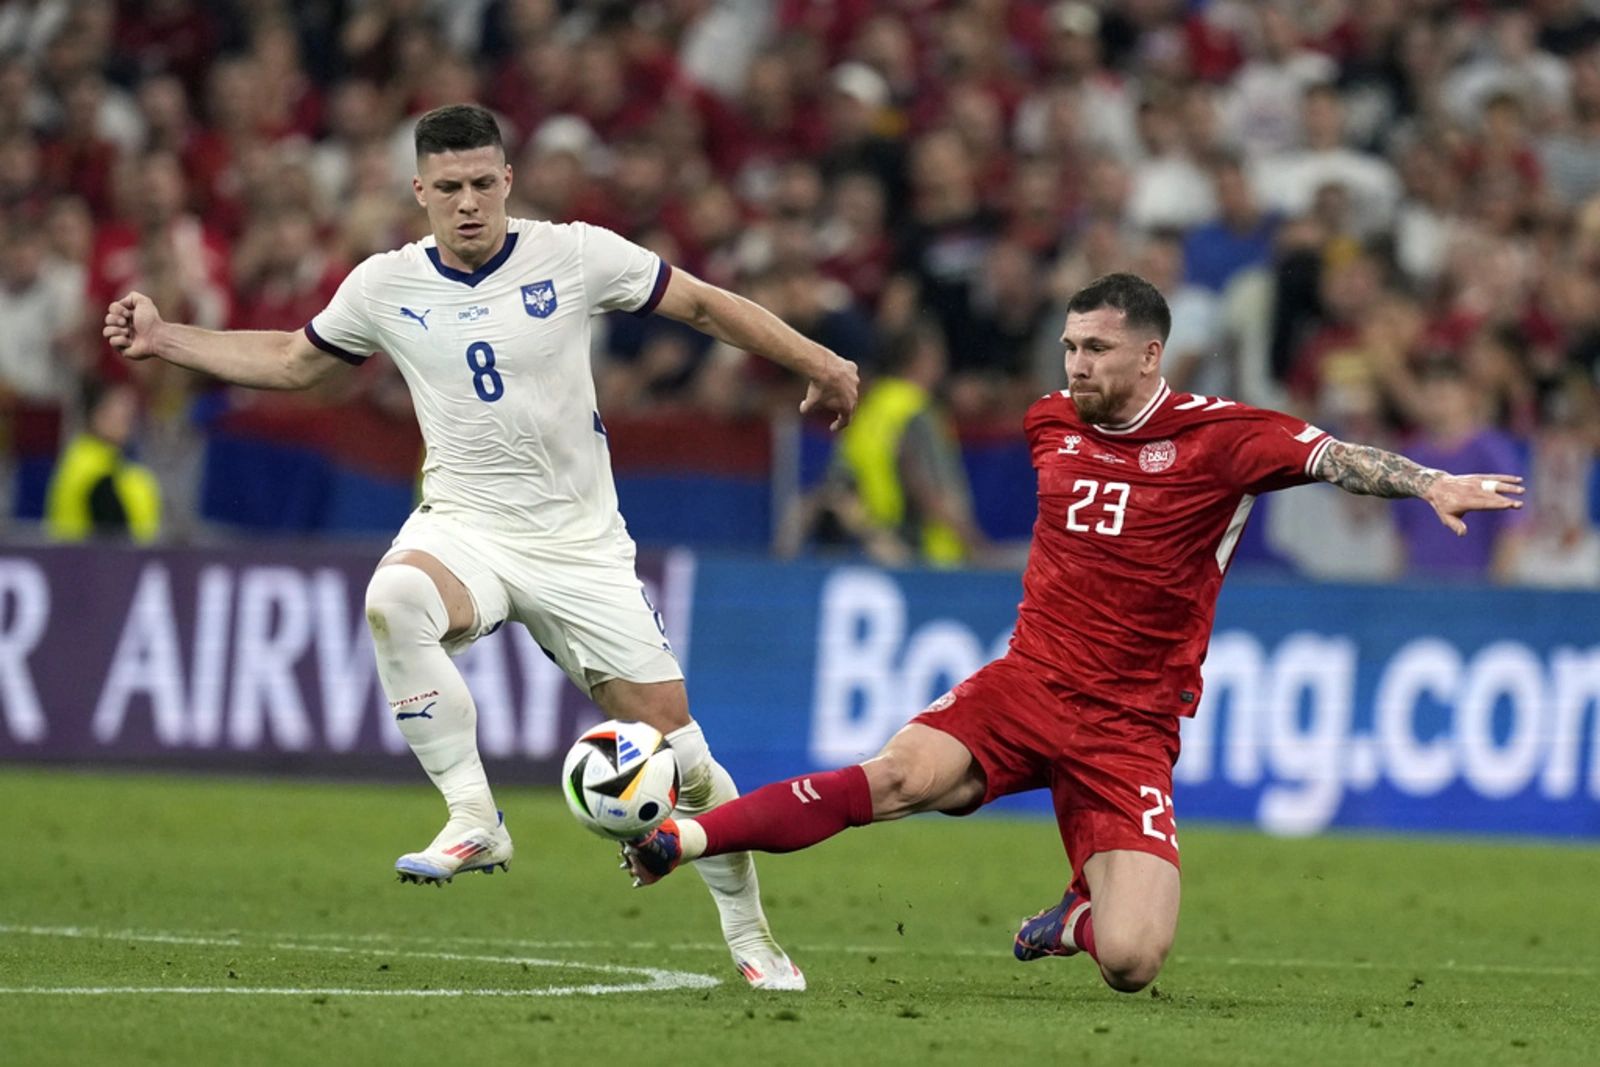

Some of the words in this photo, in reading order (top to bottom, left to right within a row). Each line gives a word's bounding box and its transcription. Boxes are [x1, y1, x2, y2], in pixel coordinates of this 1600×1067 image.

[466, 341, 504, 402] 8
[1066, 479, 1130, 536] 23
[92, 562, 625, 757] AIRWAY
[808, 566, 1600, 837] Bong.co
